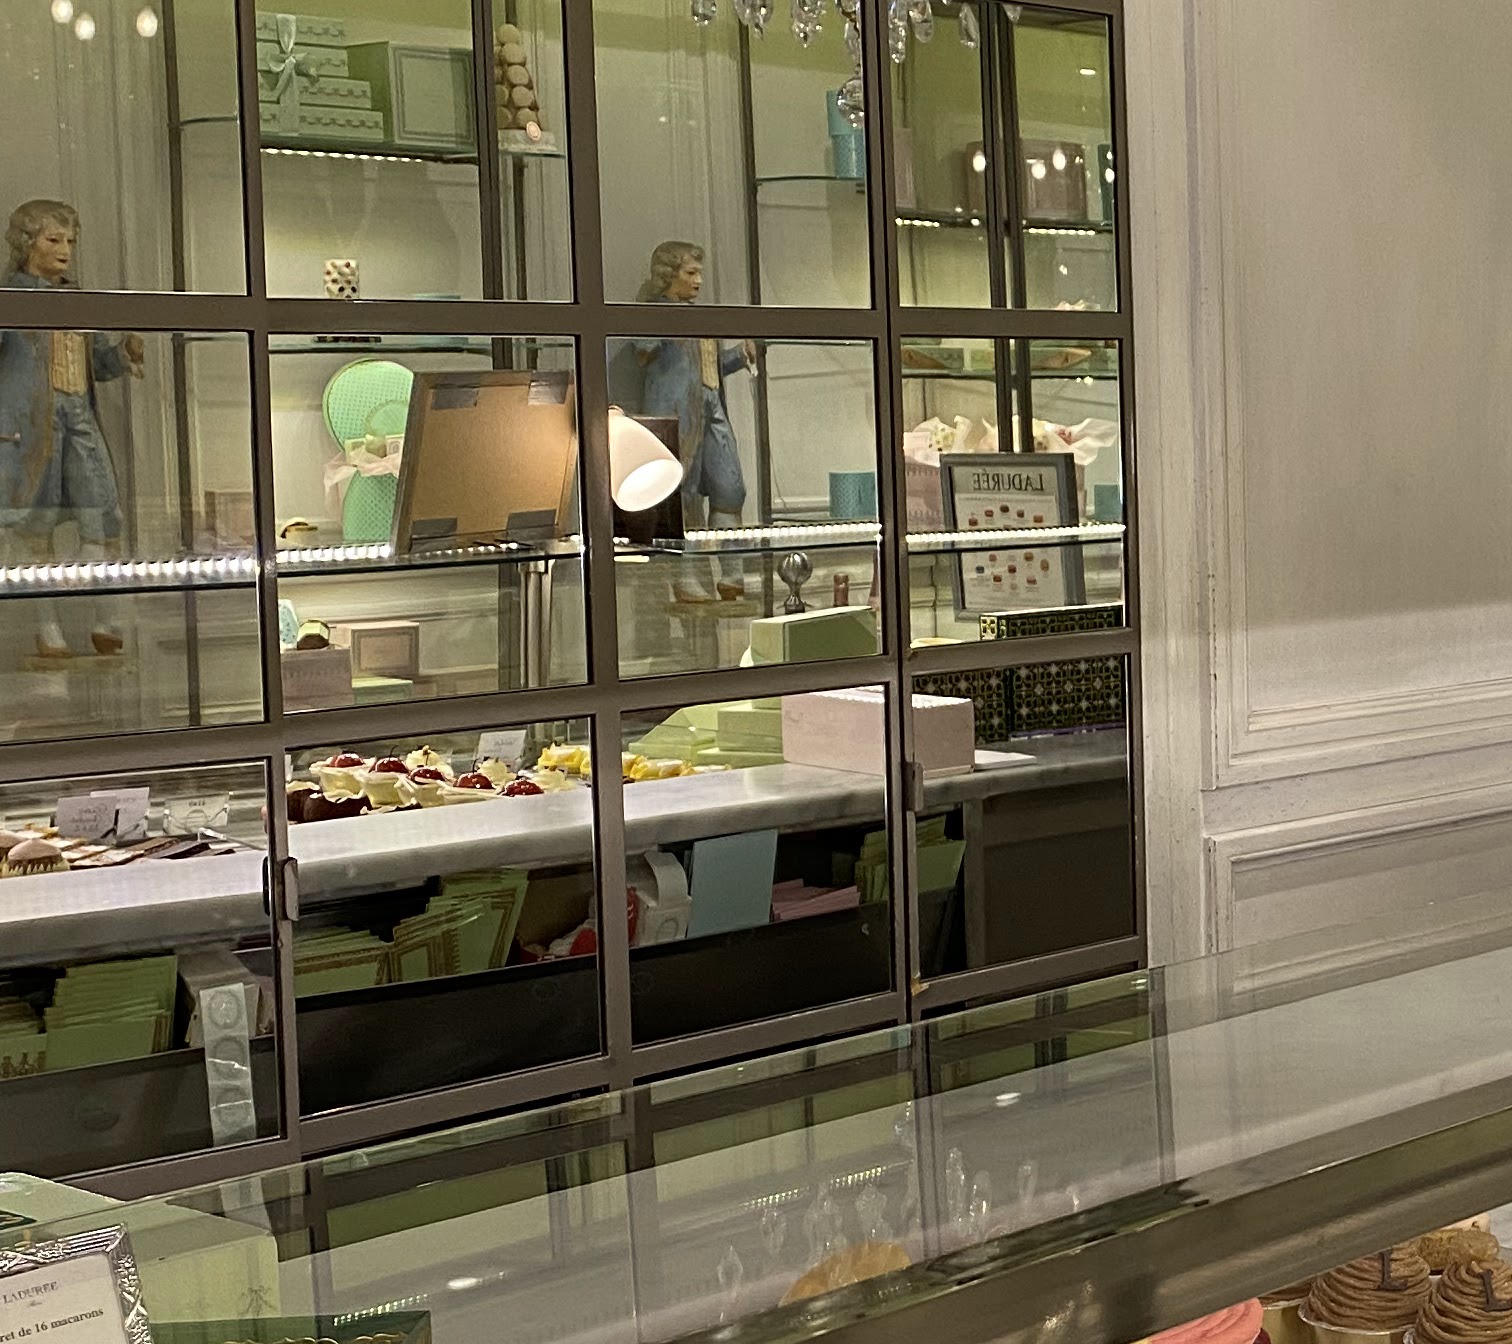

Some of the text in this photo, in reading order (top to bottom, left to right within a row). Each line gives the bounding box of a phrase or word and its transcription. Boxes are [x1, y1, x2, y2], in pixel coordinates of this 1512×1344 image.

[18, 1327, 32, 1337] de
[35, 1321, 48, 1333] 16
[51, 1308, 104, 1329] macarons
